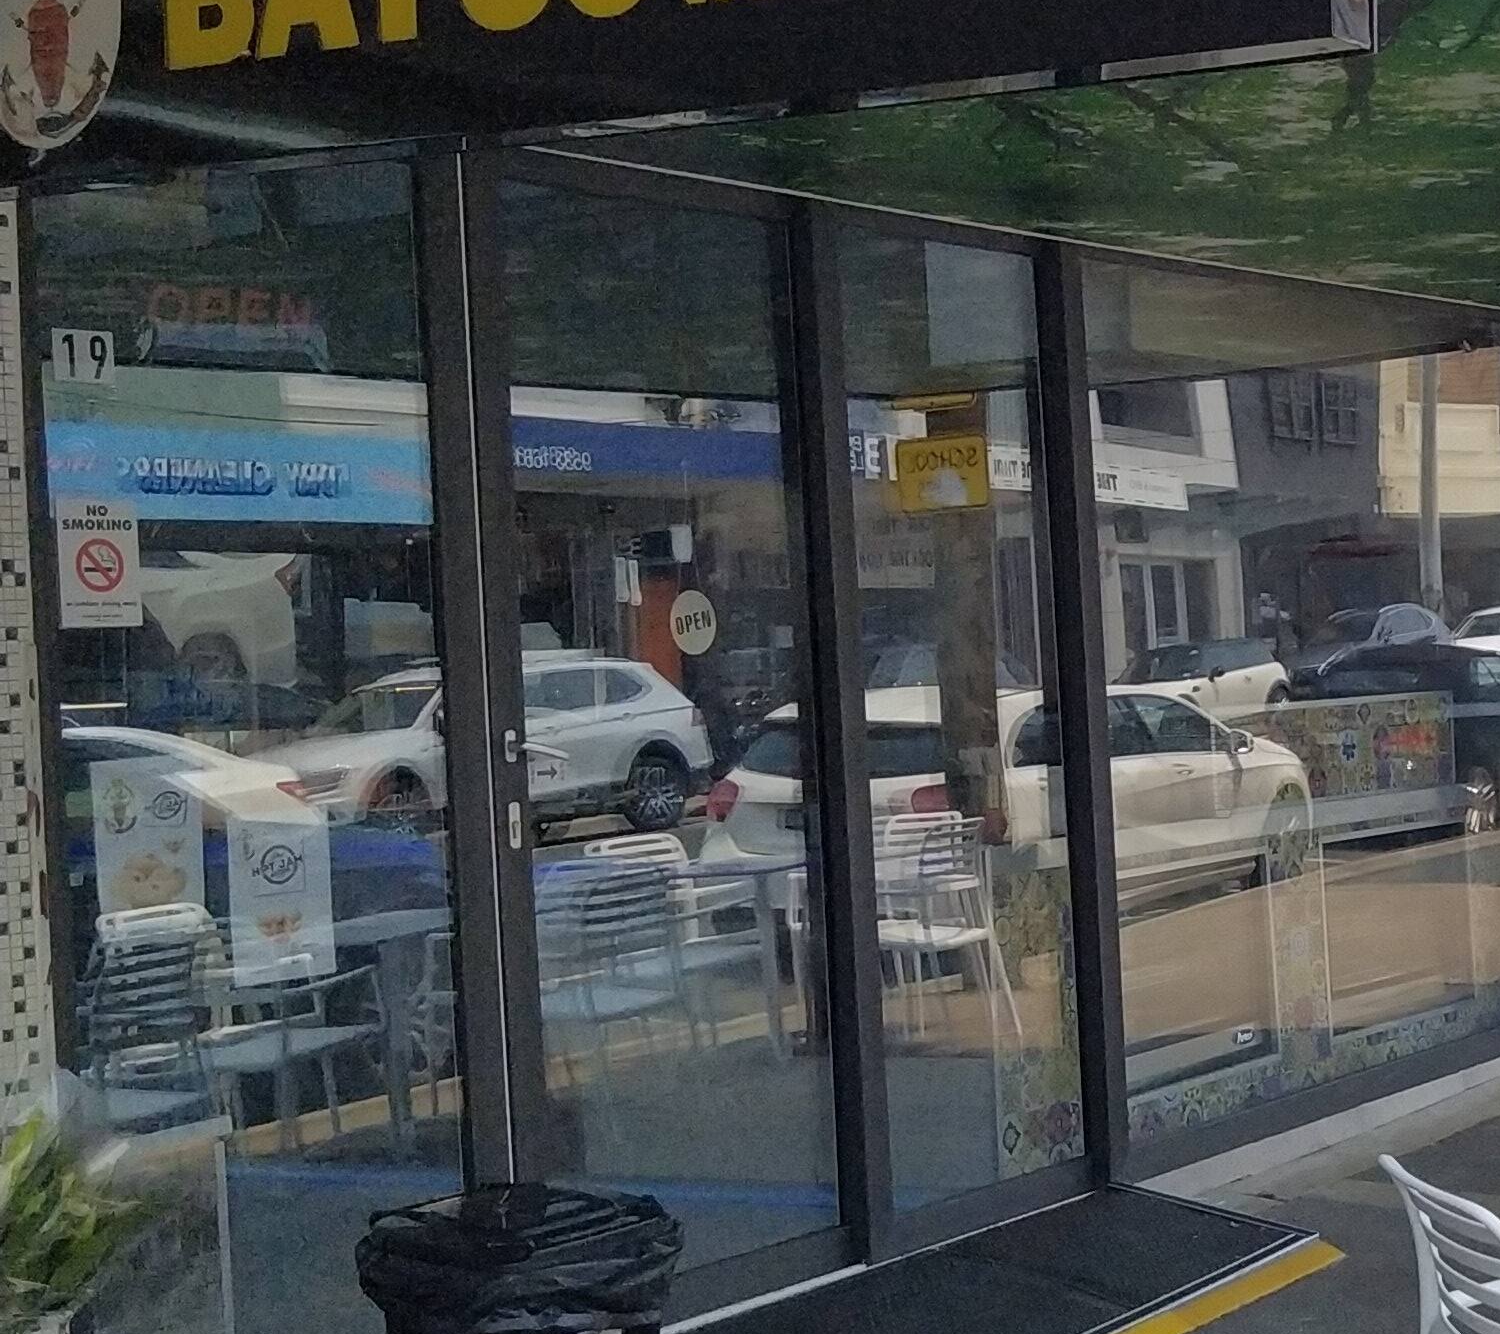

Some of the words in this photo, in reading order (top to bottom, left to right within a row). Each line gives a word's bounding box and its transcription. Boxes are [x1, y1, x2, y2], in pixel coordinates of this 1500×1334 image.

[62, 333, 107, 380] 19
[85, 504, 109, 518] NO
[61, 518, 133, 532] SMOKING
[675, 610, 712, 636] OPEN
